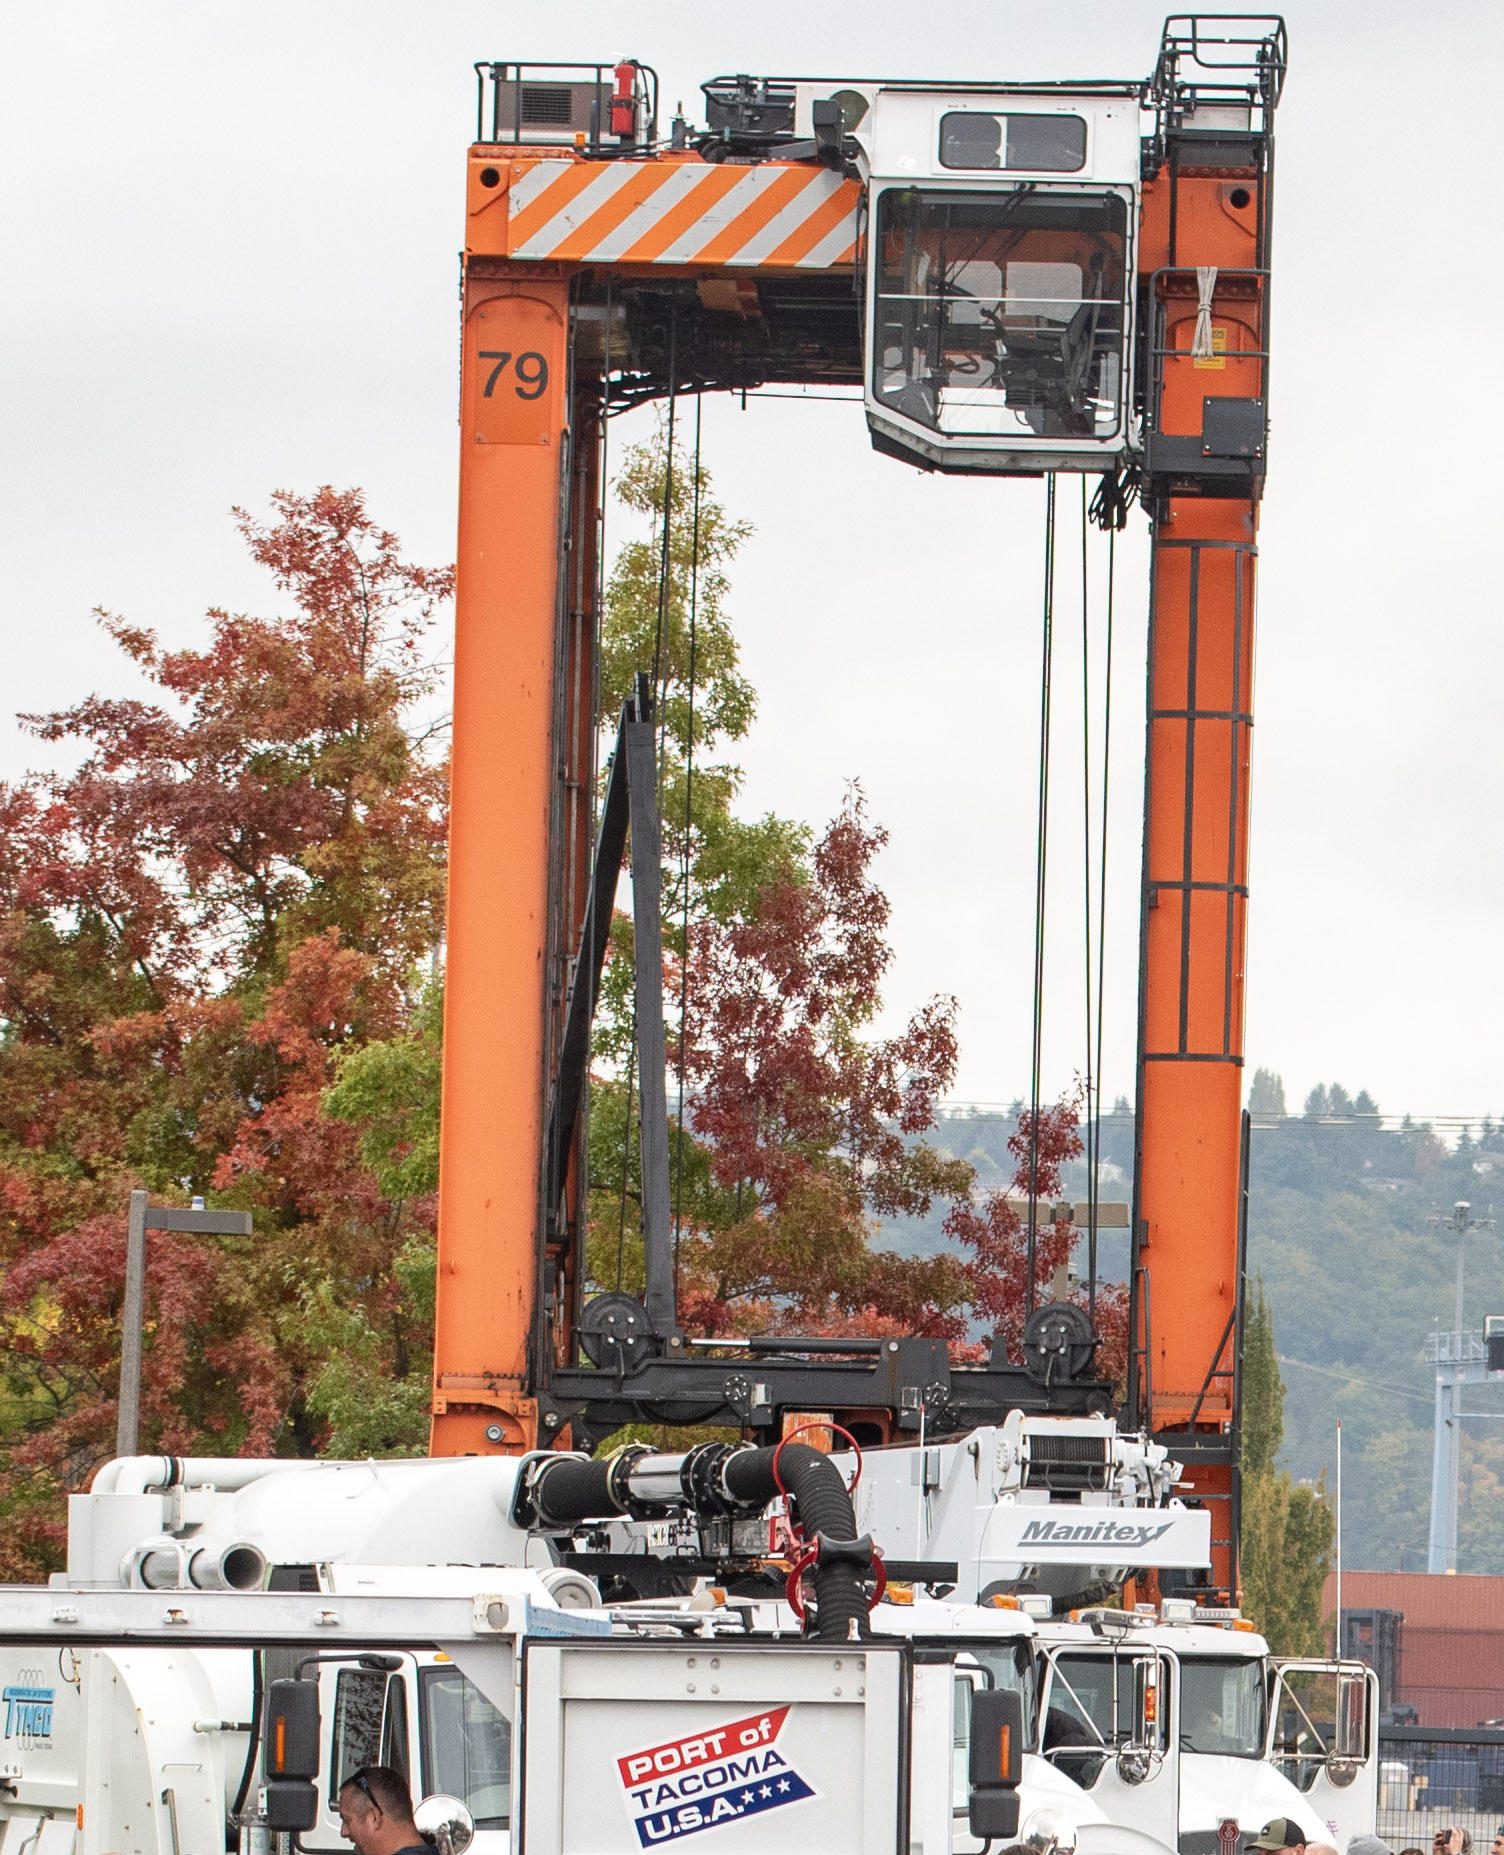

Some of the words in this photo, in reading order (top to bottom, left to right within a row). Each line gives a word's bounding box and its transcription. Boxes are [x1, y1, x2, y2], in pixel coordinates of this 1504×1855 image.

[478, 351, 548, 400] 79
[1021, 1520, 1156, 1545] Manitex
[627, 1731, 726, 1781] PORT
[739, 1718, 771, 1746] of
[631, 1750, 787, 1809] TACOMA
[645, 1797, 745, 1840] U.S.A.
